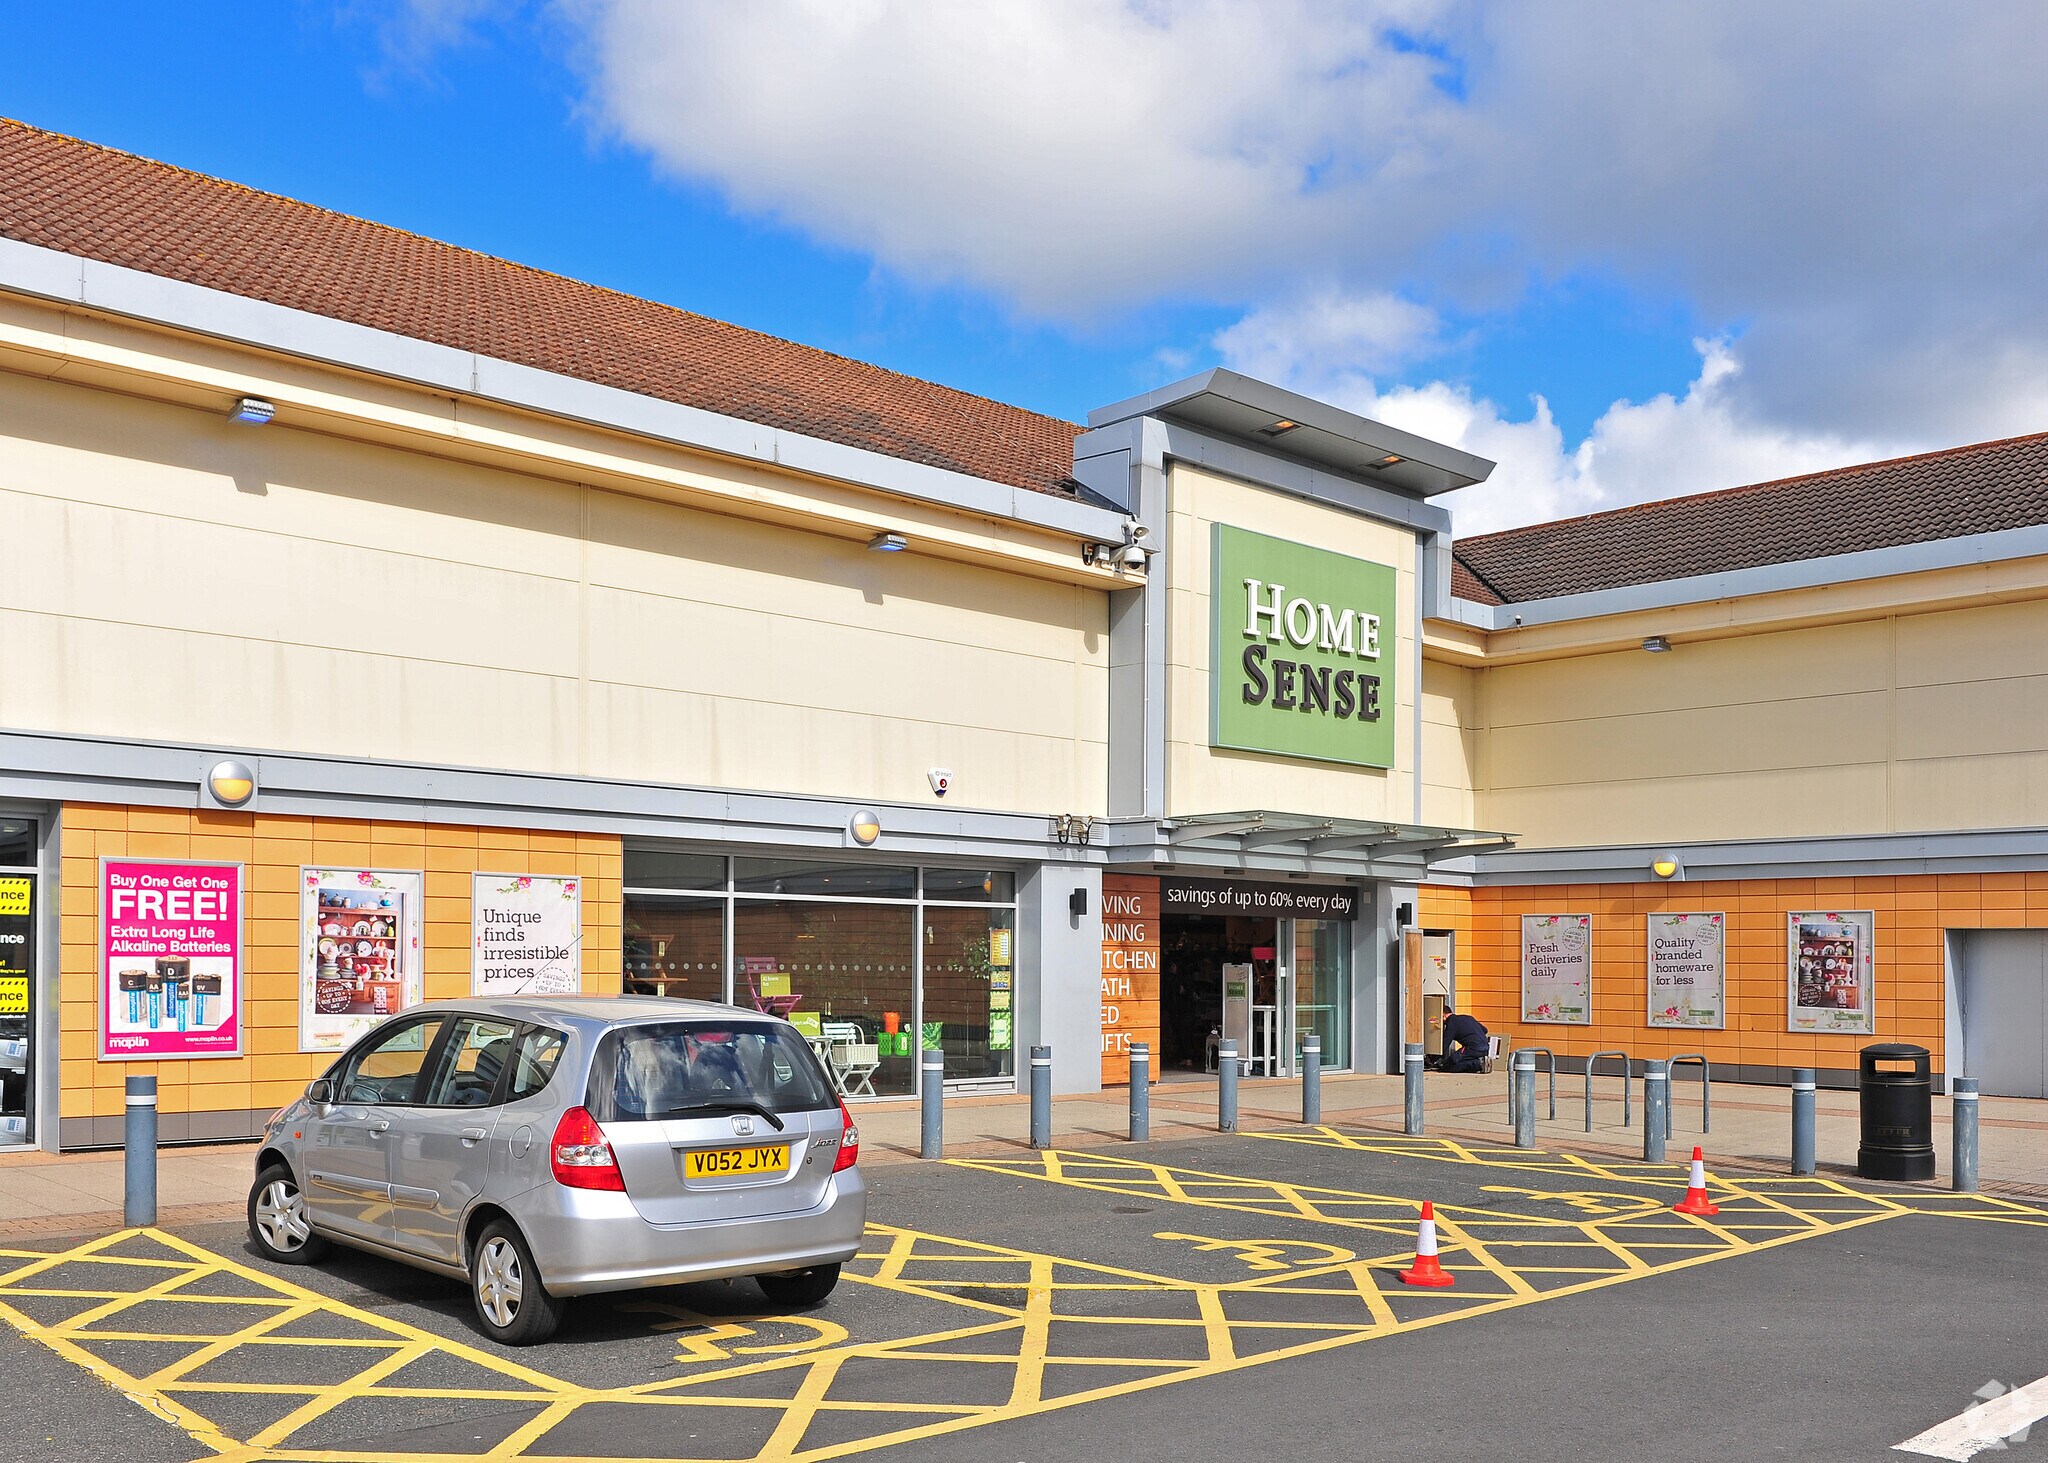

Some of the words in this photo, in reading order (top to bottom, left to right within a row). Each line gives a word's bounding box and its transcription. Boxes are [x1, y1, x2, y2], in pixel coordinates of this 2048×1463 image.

[1243, 578, 1380, 659] HOME
[1242, 644, 1380, 720] SENSE
[110, 874, 137, 888] Buy
[140, 874, 169, 888] One
[172, 876, 197, 888] Get
[200, 877, 228, 888] One
[112, 888, 228, 921] FREE!
[1167, 886, 1216, 908] savings
[1218, 887, 1232, 904] of
[1235, 893, 1250, 910] up
[1254, 894, 1266, 906] to
[1270, 892, 1293, 908] 60%
[1296, 896, 1329, 913] every
[1331, 894, 1352, 914] day
[483, 908, 542, 927] Unique
[111, 926, 148, 938] Extra
[152, 926, 186, 940] Long
[190, 926, 216, 938] Life
[484, 928, 525, 942] finds
[110, 940, 166, 952] Alkaline
[170, 940, 231, 952] Batteries
[1530, 943, 1558, 953] Fresh
[1654, 938, 1695, 949] Quality
[484, 946, 569, 960] irresistible
[1530, 955, 1582, 965] deliveries
[1655, 950, 1702, 961] branded
[168, 968, 174, 976] D
[484, 964, 535, 982] prices
[1531, 966, 1557, 978] daily
[1656, 963, 1714, 973] homeware
[1656, 976, 1670, 986] for
[1674, 976, 1694, 984] less
[110, 1036, 149, 1049] maplin
[694, 1151, 742, 1172] VO52
[748, 1148, 782, 1168] JYX
